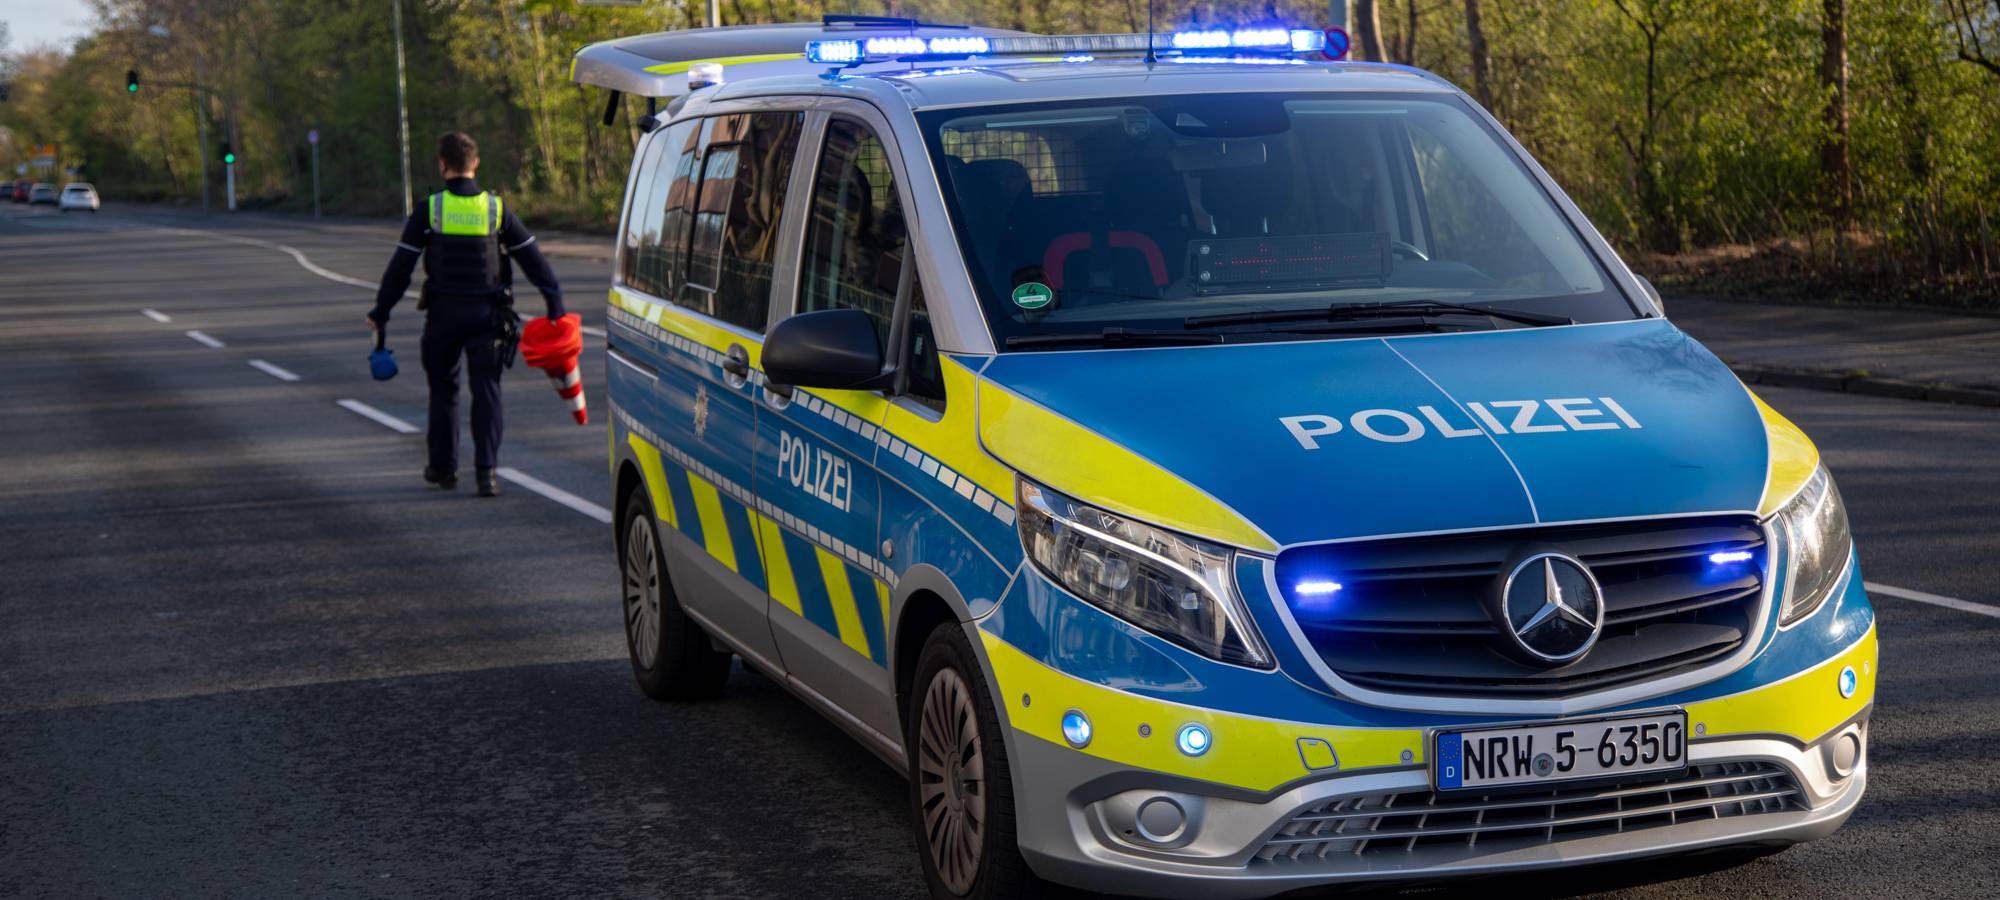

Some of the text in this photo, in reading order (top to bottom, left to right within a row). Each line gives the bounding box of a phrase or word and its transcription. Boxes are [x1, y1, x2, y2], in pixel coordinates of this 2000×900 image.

[446, 213, 485, 225] POLIZEI
[1279, 397, 1642, 449] POLIZEI
[778, 430, 851, 512] POLIZEI
[1446, 766, 1454, 778] D
[1463, 722, 1681, 780] NRW 5-6350
